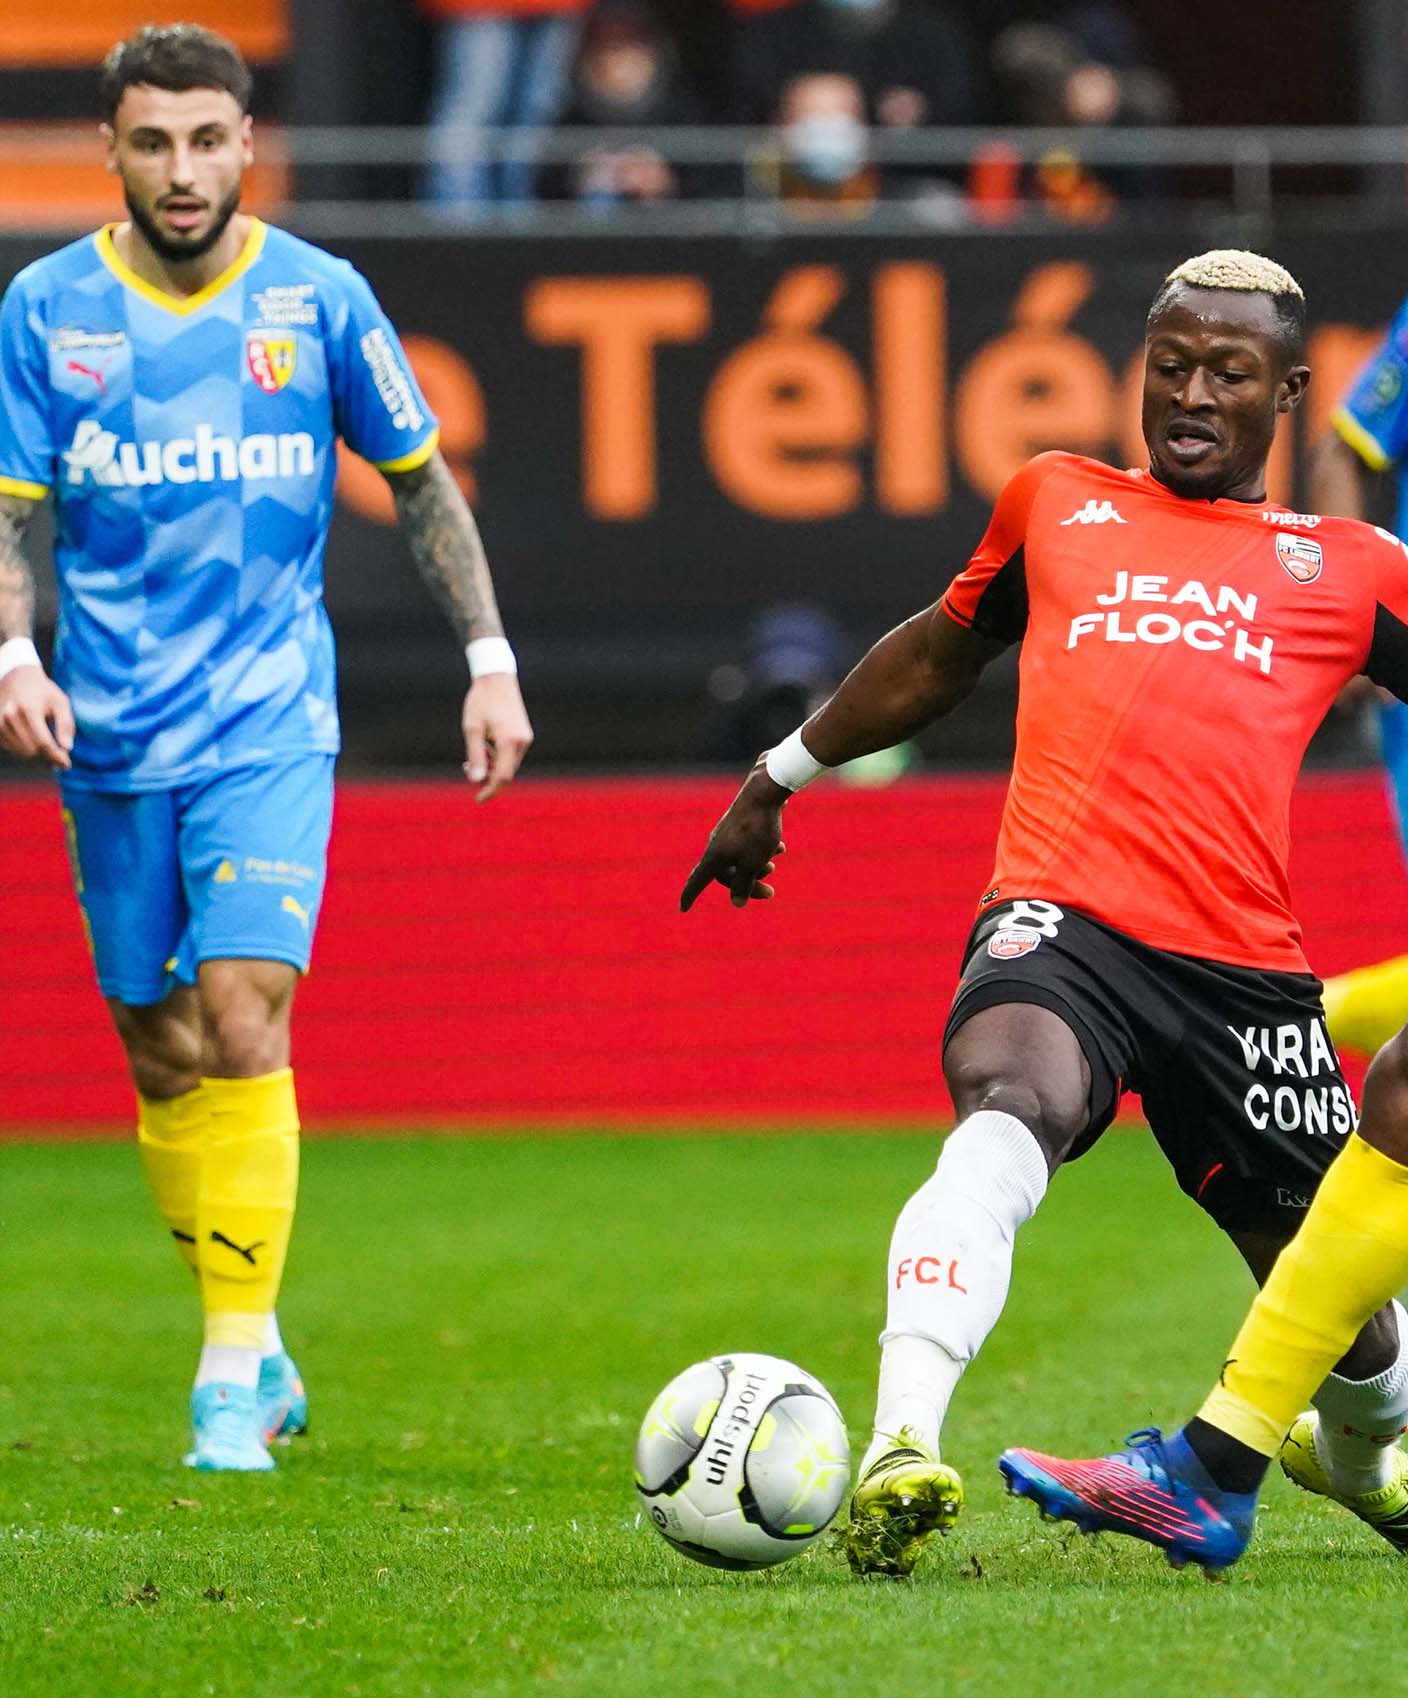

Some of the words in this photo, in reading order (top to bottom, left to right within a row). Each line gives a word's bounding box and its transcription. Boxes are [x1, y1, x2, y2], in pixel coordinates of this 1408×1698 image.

[61, 419, 315, 487] Auchan
[1096, 570, 1259, 622] JEAN
[1067, 611, 1274, 675] FLOC'H
[998, 899, 1065, 939] 8
[1226, 1015, 1340, 1078] VIRA
[896, 1256, 968, 1296] FCL
[705, 1373, 768, 1486] uhlsport
